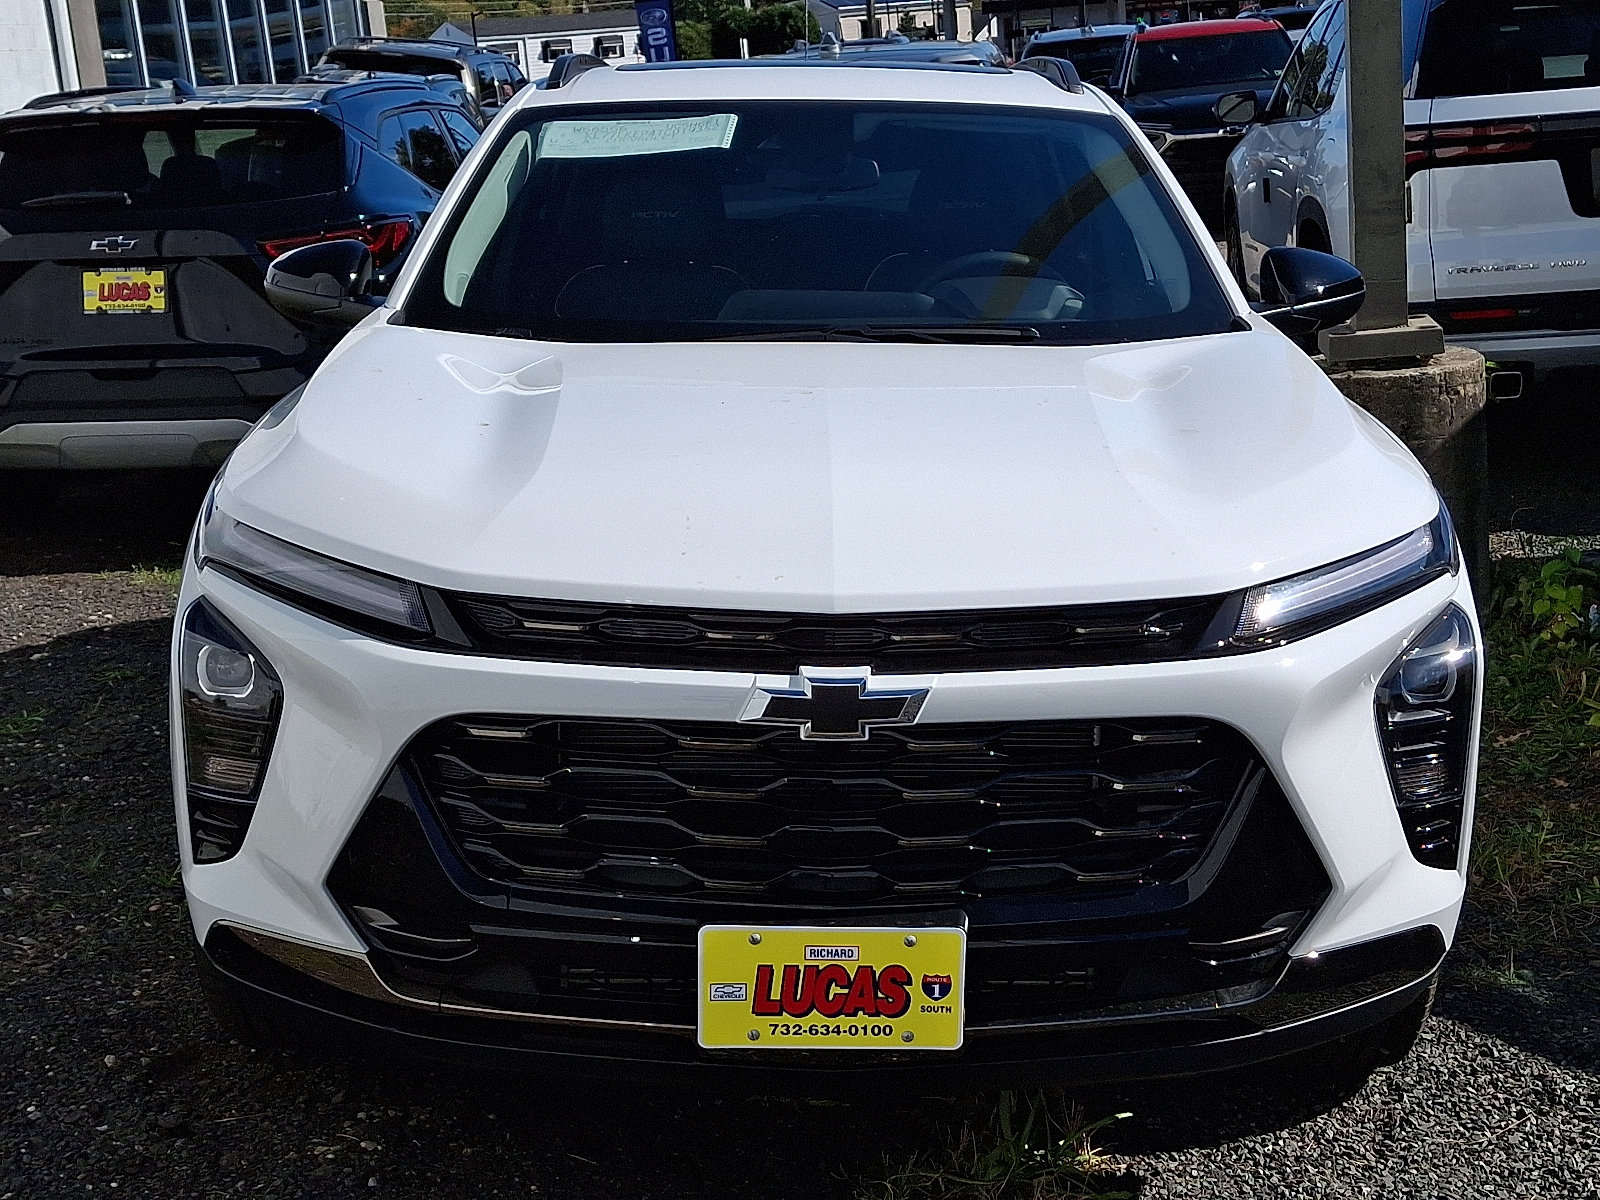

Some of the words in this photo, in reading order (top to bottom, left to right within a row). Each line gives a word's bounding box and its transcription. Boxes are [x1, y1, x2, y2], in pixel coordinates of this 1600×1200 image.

[1447, 263, 1540, 275] TRAVERSE
[99, 282, 151, 301] LUCAS
[809, 948, 855, 959] RICHARD
[752, 964, 912, 1018] LUCAS
[930, 983, 942, 998] 1
[920, 1005, 952, 1014] SOUTH
[768, 1023, 894, 1037] 732-634-0100
